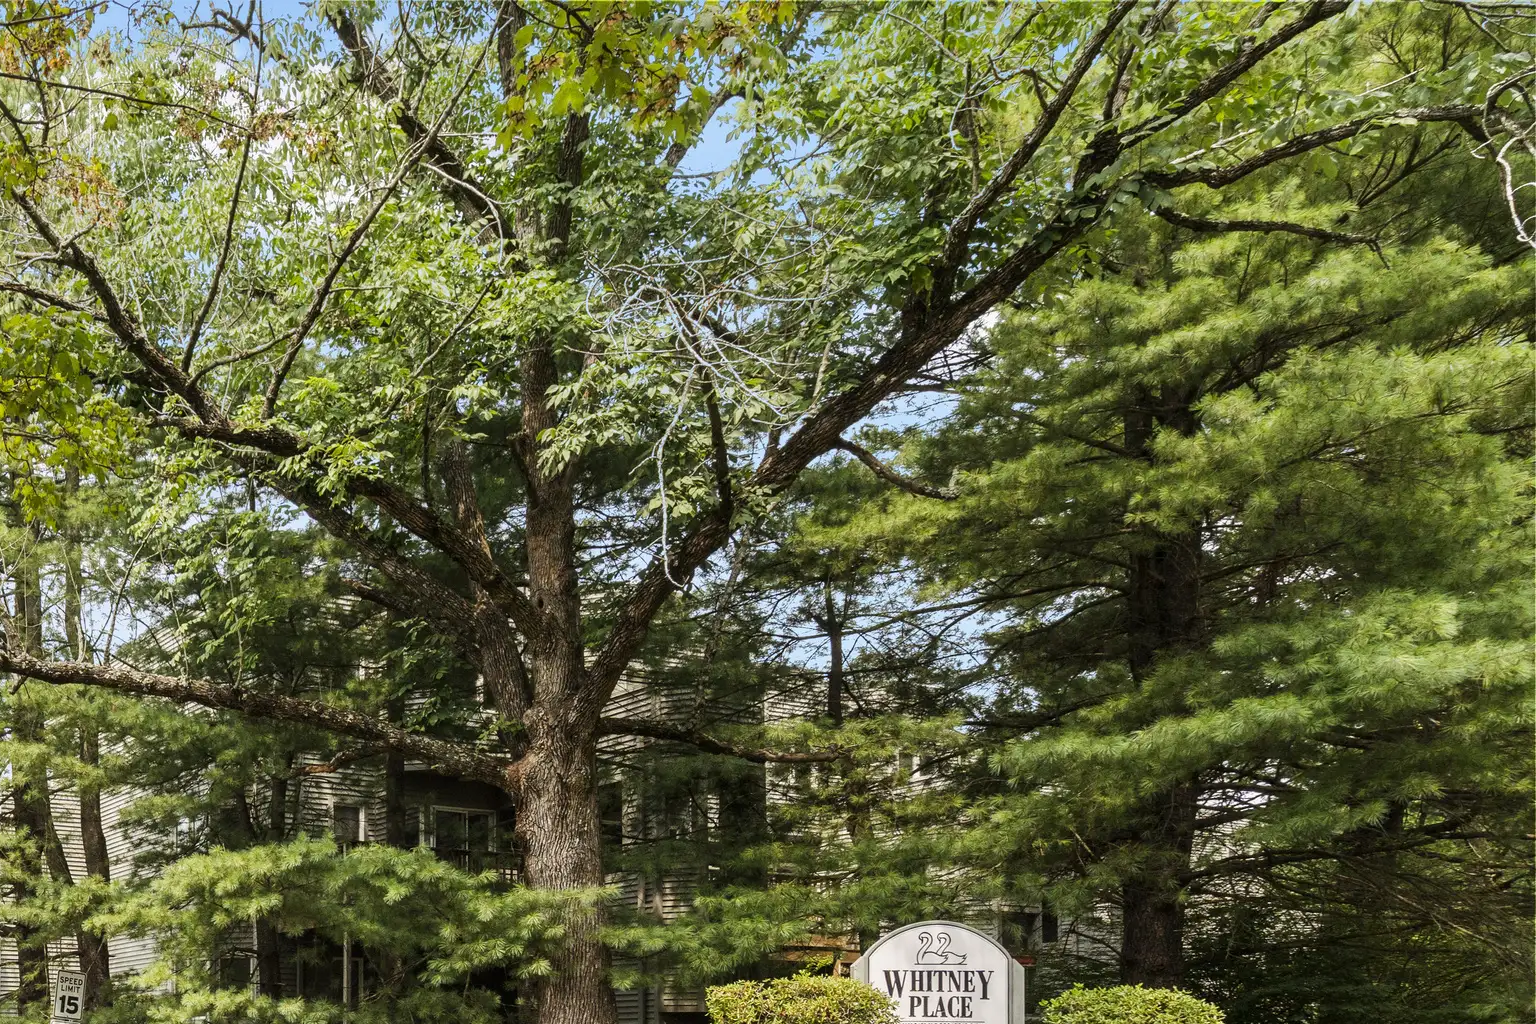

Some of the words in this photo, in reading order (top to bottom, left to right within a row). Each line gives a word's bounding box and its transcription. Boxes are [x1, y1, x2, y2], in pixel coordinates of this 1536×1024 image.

[60, 976, 83, 986] SPEED
[61, 985, 81, 993] LIMIT
[882, 969, 995, 1001] WHITNEY
[59, 994, 79, 1015] 15
[908, 995, 973, 1019] PLACE
